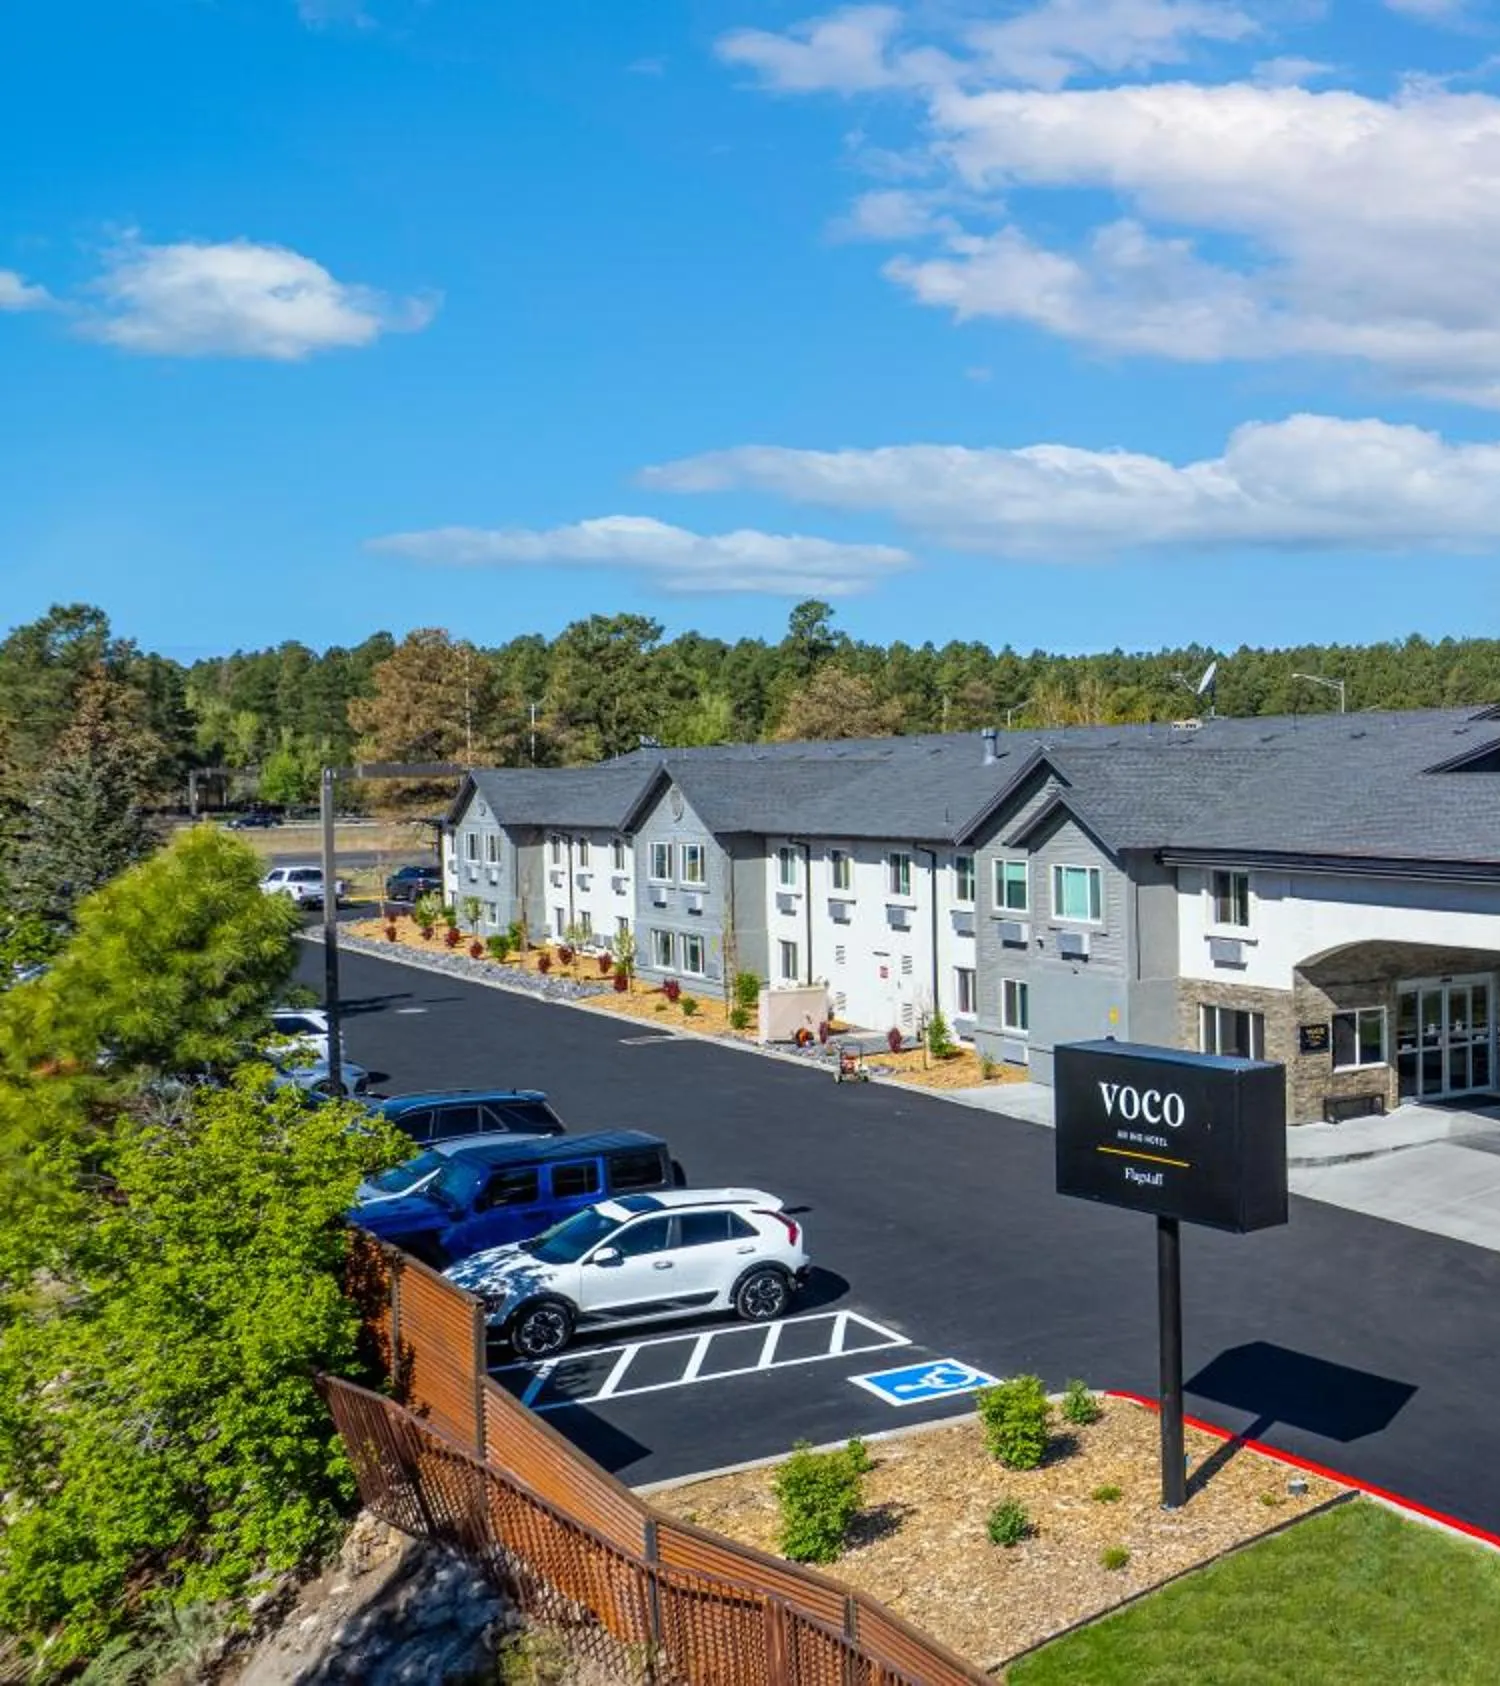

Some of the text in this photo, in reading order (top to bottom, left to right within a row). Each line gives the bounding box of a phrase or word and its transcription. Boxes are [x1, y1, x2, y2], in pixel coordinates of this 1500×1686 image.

[1098, 1081, 1185, 1128] VOCO
[1144, 1134, 1168, 1147] HOTEL
[1125, 1167, 1163, 1185] Flagstaff
